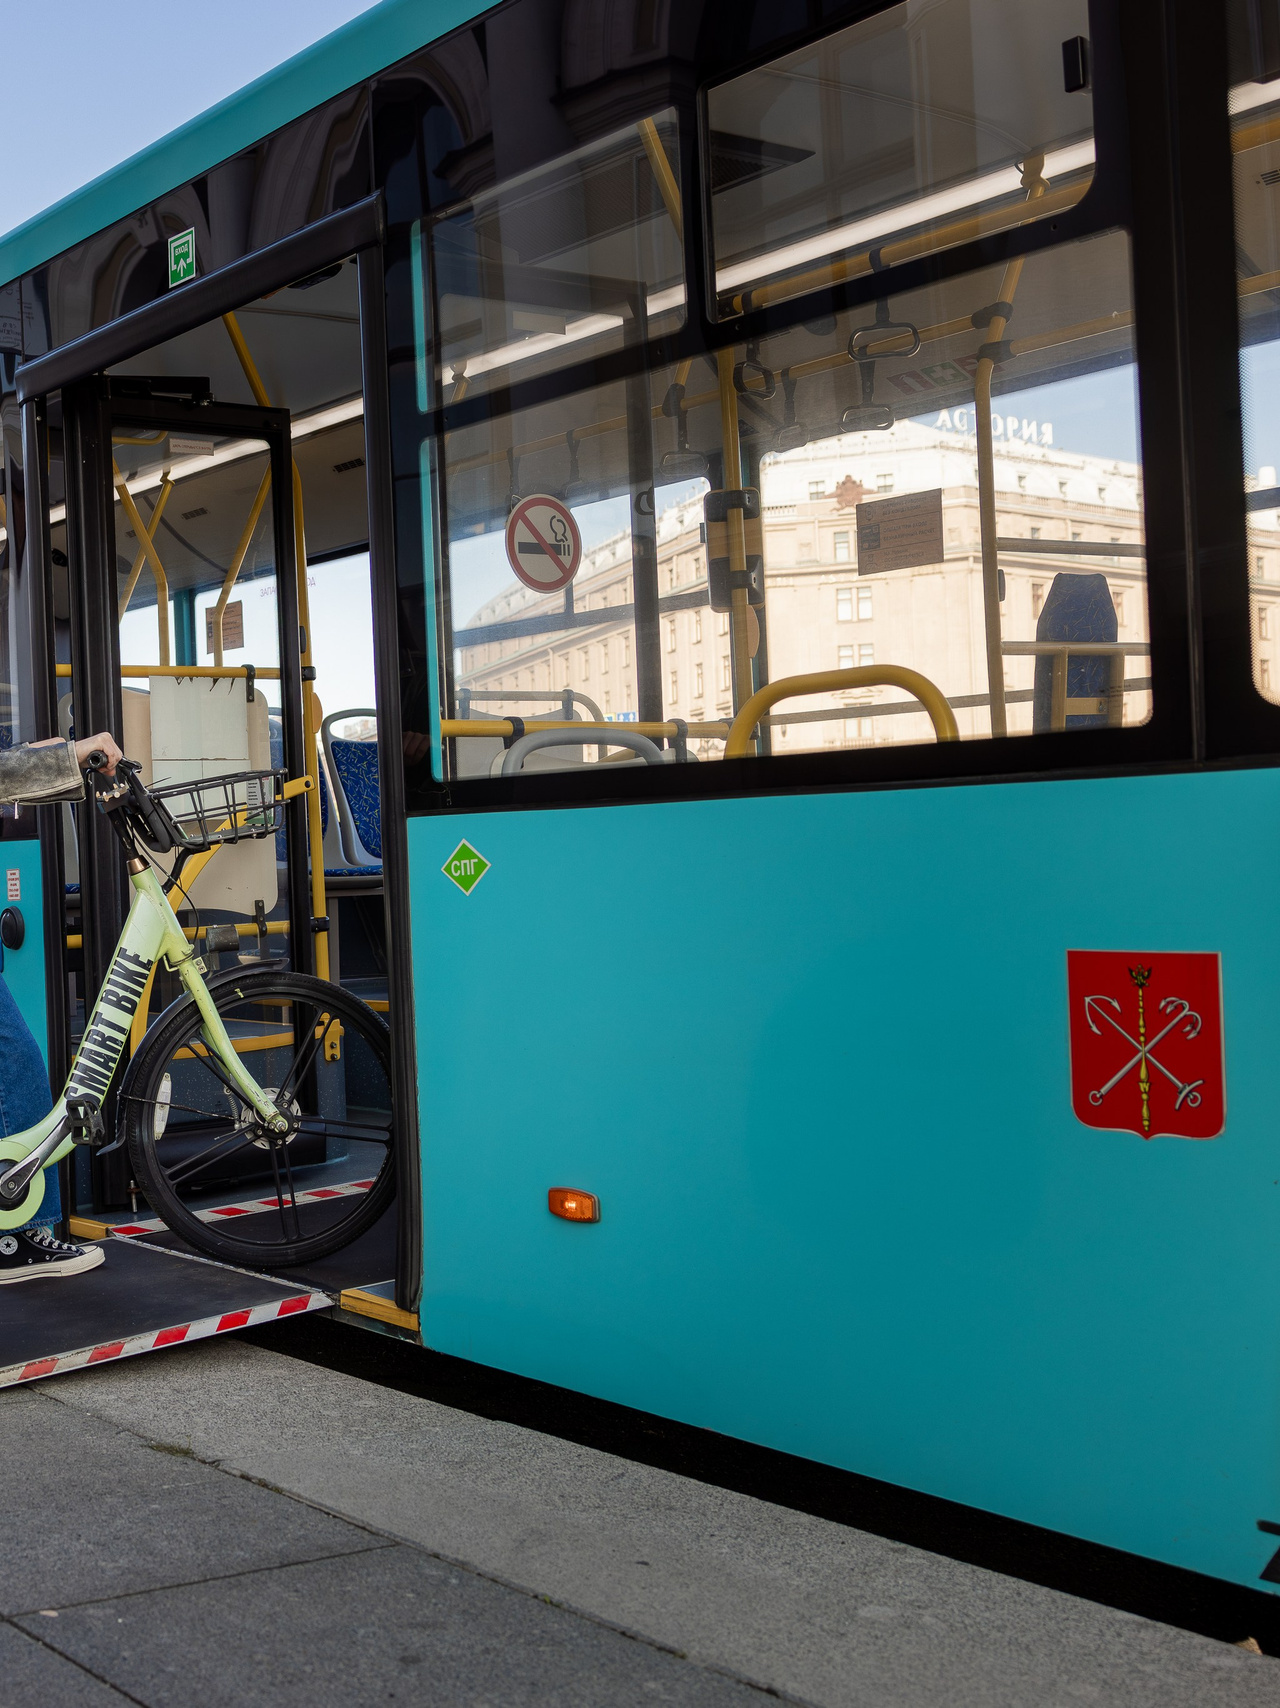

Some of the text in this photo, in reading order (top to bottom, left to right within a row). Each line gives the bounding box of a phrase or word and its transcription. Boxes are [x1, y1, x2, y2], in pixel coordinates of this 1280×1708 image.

[175, 243, 189, 256] ВХОД
[451, 858, 479, 877] СПГ
[63, 946, 155, 1110] SMART BIKE
